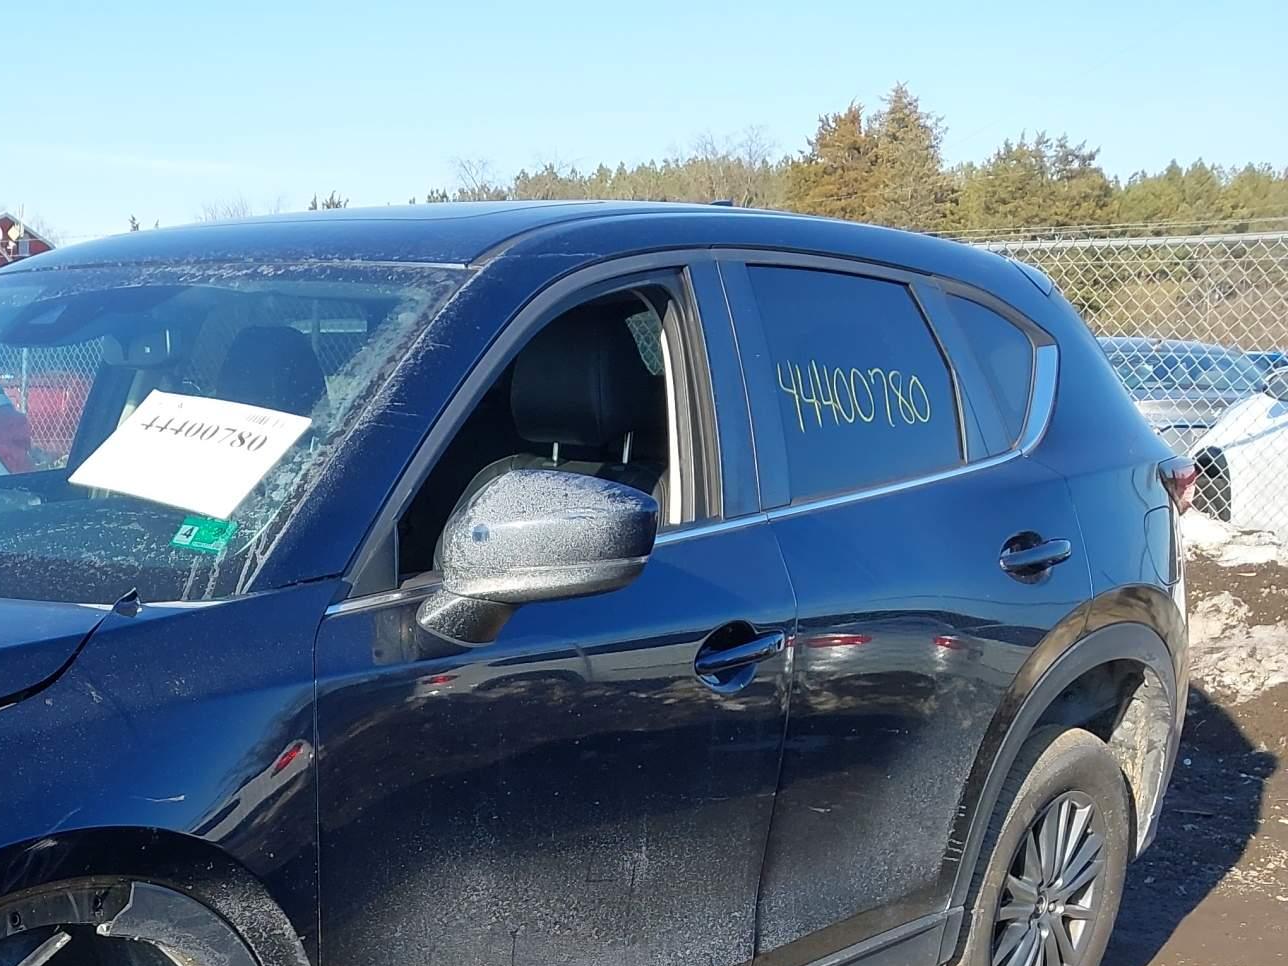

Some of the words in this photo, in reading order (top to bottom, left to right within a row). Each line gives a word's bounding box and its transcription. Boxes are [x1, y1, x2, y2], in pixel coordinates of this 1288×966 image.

[776, 359, 931, 433] 44400780
[140, 414, 269, 452] 44400780
[180, 526, 195, 539] 4
